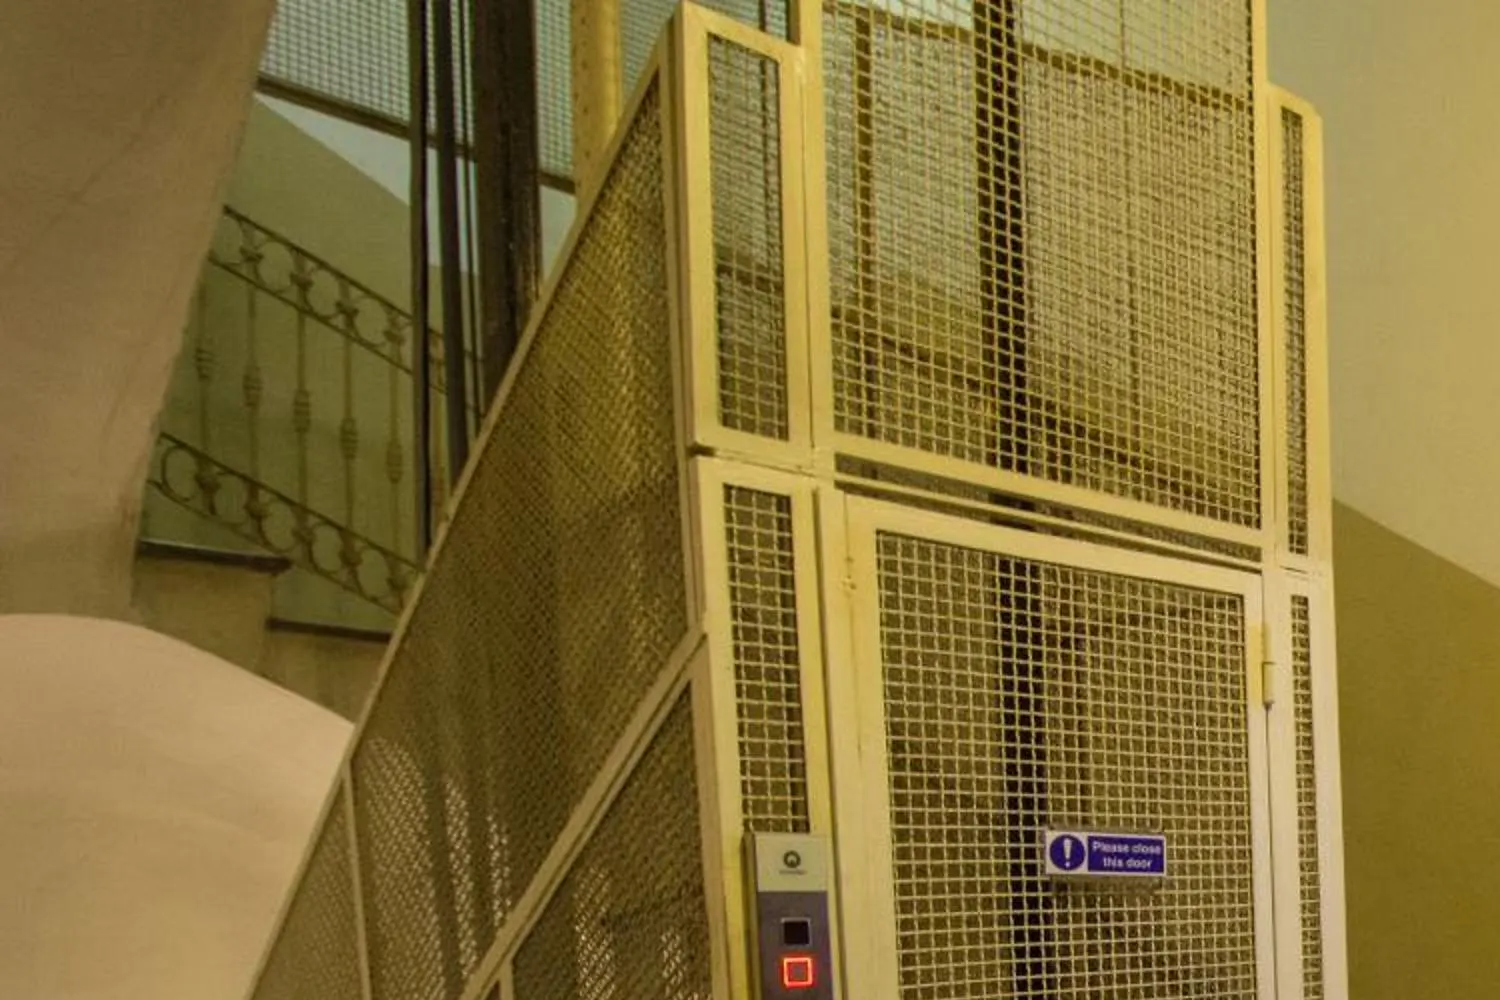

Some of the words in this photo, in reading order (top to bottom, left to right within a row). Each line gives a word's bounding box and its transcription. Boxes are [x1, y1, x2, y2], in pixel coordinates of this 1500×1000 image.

[1091, 840, 1130, 854] Please
[1131, 842, 1162, 856] close
[1103, 856, 1124, 868] this
[1125, 857, 1153, 869] door
